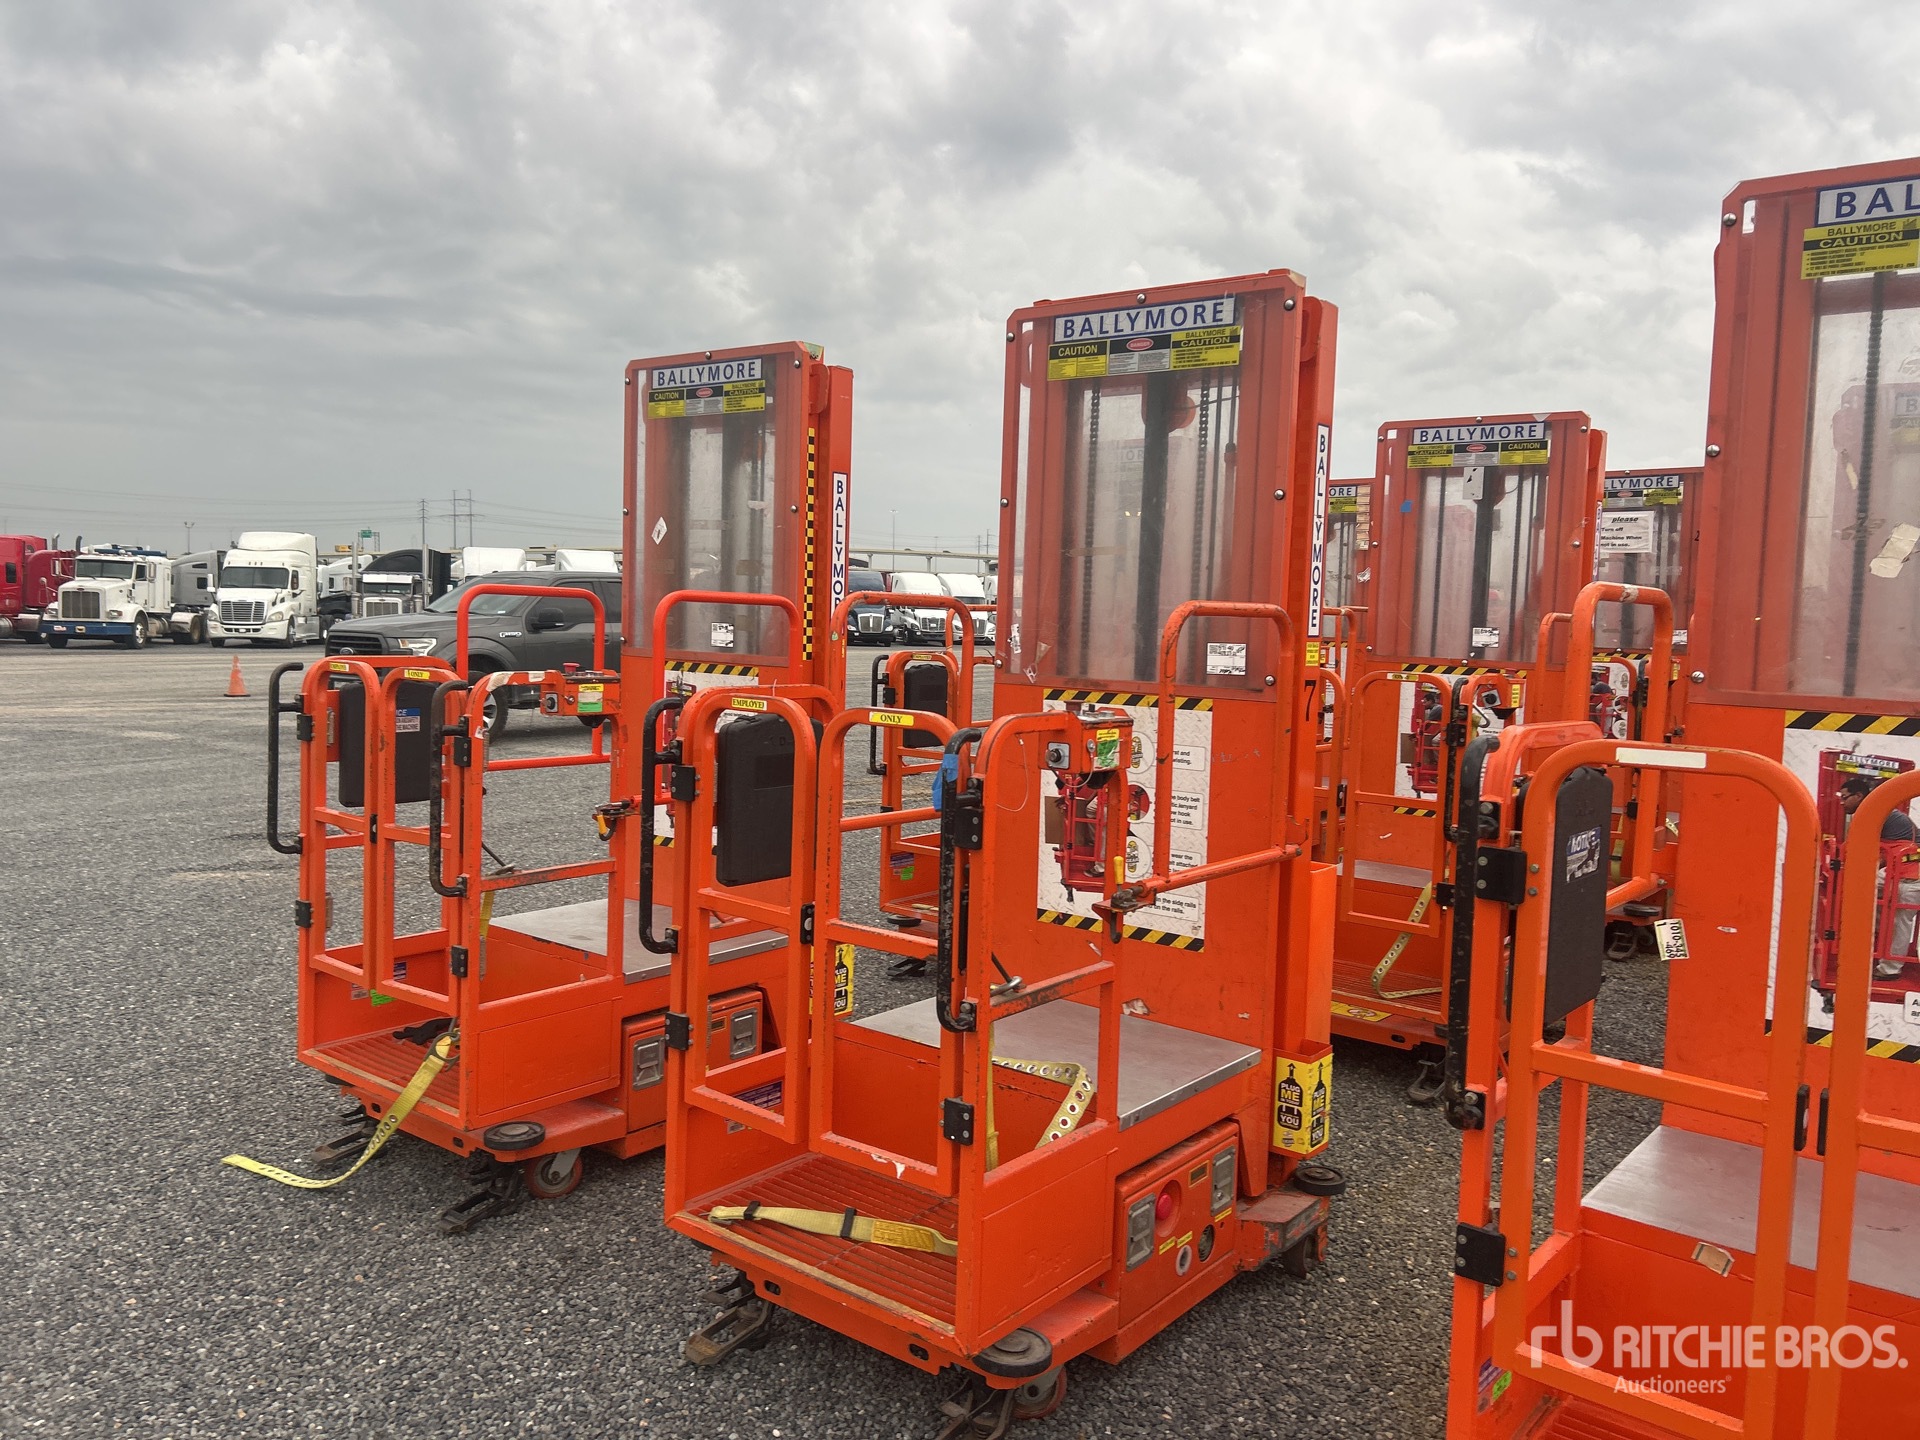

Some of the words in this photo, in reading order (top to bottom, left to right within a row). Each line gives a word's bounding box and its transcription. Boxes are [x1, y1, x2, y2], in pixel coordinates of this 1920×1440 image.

[1828, 222, 1896, 237] BALLYMORE
[1820, 232, 1903, 248] CAUTION
[1063, 302, 1224, 338] BALLYMORE
[1185, 328, 1226, 339] BALLYMORE
[1180, 337, 1230, 348] CAUTION
[1058, 345, 1098, 357] CAUTION
[658, 362, 756, 386] BALLYMORE
[654, 392, 680, 400] CAUTION
[1420, 424, 1537, 442] BALLYMORE
[1311, 434, 1326, 628] BALLYMORE
[1304, 680, 1316, 721] 7
[880, 714, 903, 724] ONLY
[1842, 755, 1896, 768] BALLYMORE
[1281, 1082, 1300, 1092] PLUG
[1281, 1089, 1300, 1102] ME
[1313, 1094, 1325, 1111] ME
[1280, 1115, 1299, 1126] YOU
